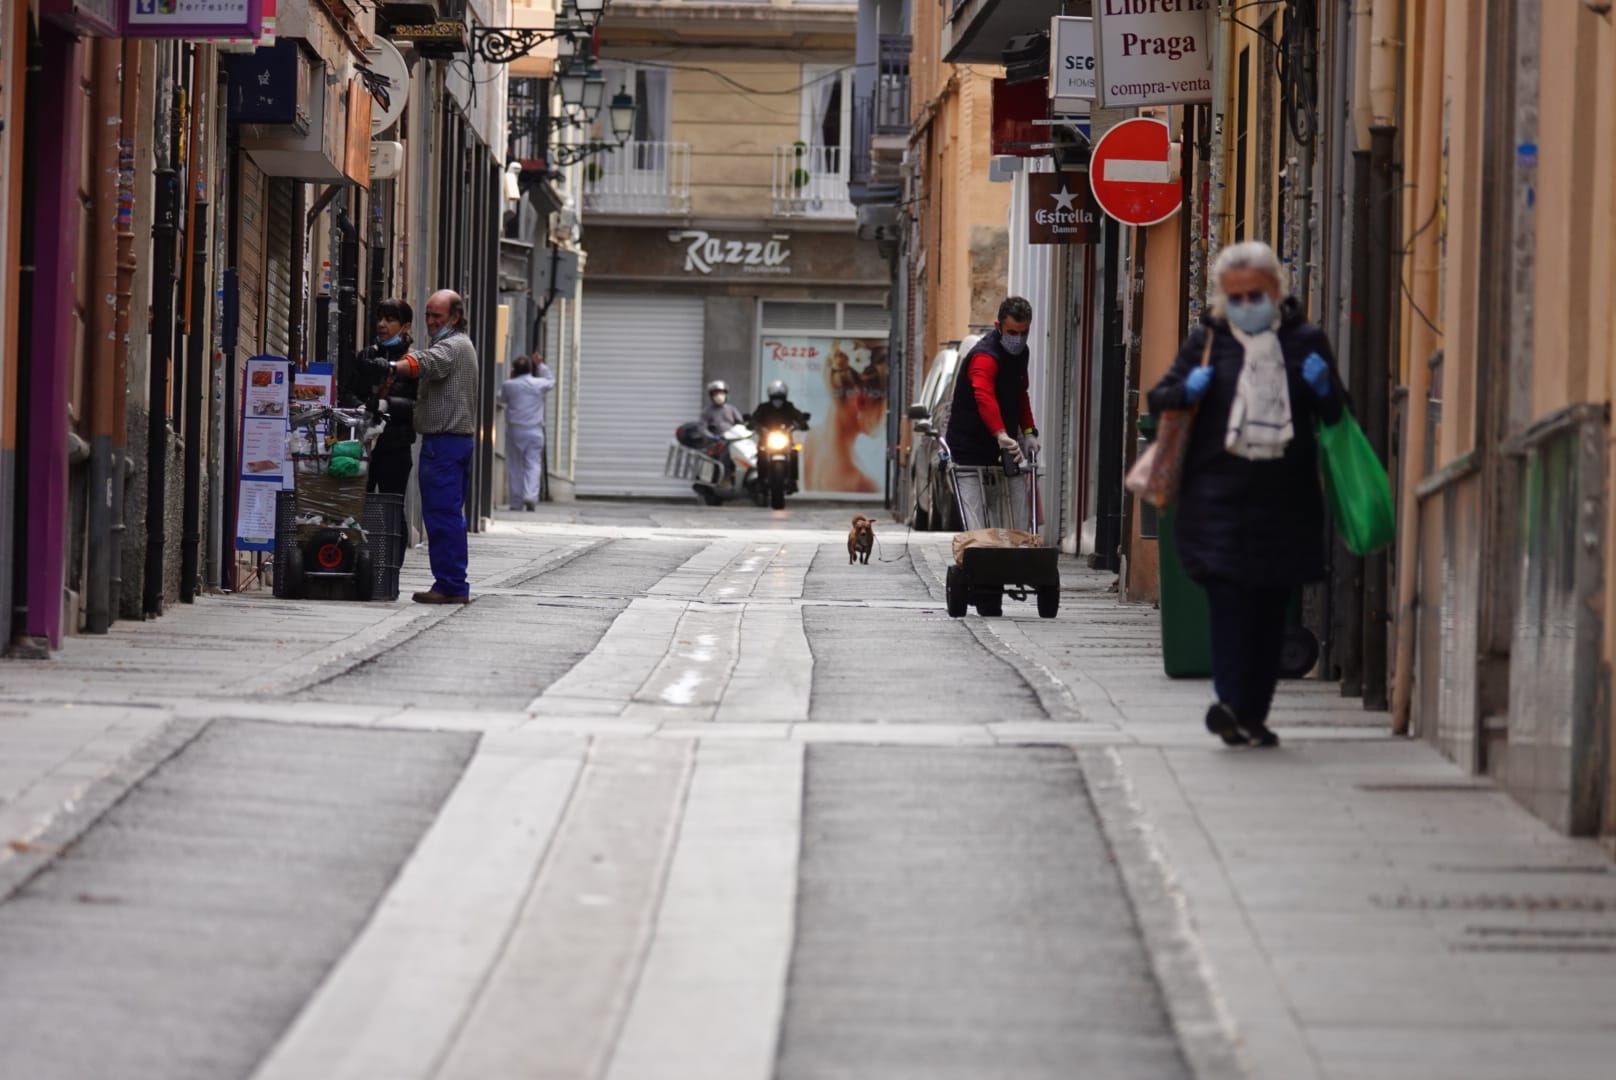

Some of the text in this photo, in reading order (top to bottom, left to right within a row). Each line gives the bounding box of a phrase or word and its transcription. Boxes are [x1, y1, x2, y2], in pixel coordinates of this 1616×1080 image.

[179, 2, 244, 11] terrestre
[1120, 33, 1197, 61] Praga
[1111, 78, 1211, 98] compra-venta
[1035, 208, 1093, 225] Estrella
[1052, 224, 1078, 234] Damm
